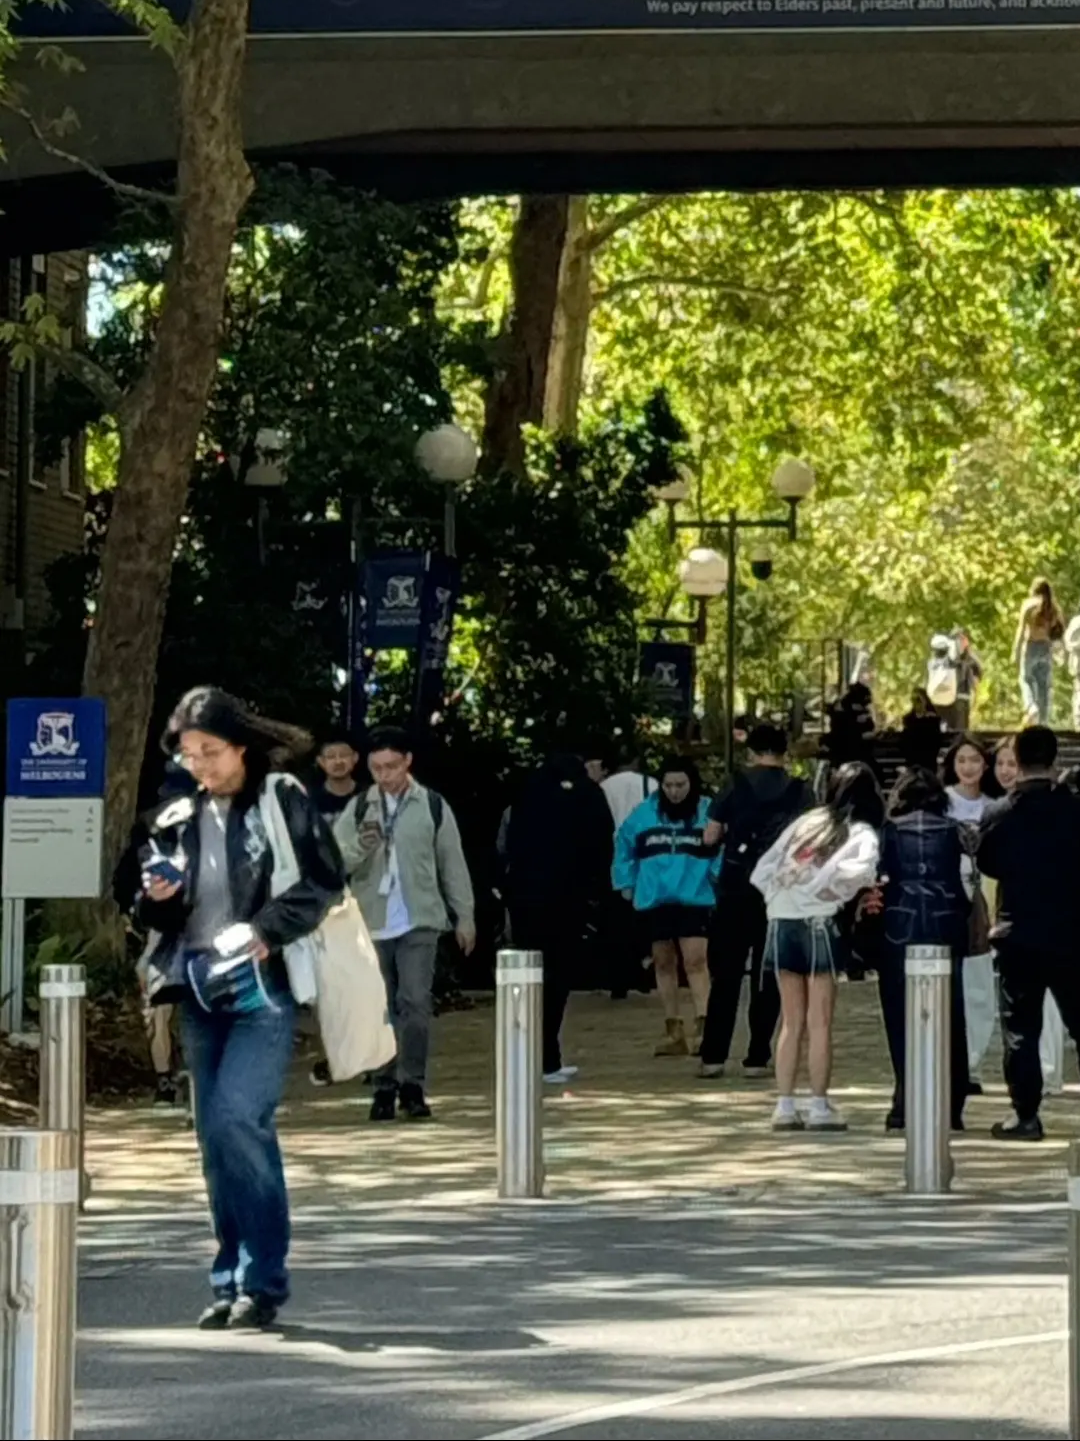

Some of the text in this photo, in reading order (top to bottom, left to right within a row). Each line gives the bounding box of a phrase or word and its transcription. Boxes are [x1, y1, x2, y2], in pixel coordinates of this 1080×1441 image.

[647, 0, 669, 13] We
[672, 2, 697, 16] pay
[700, 0, 754, 15] respect
